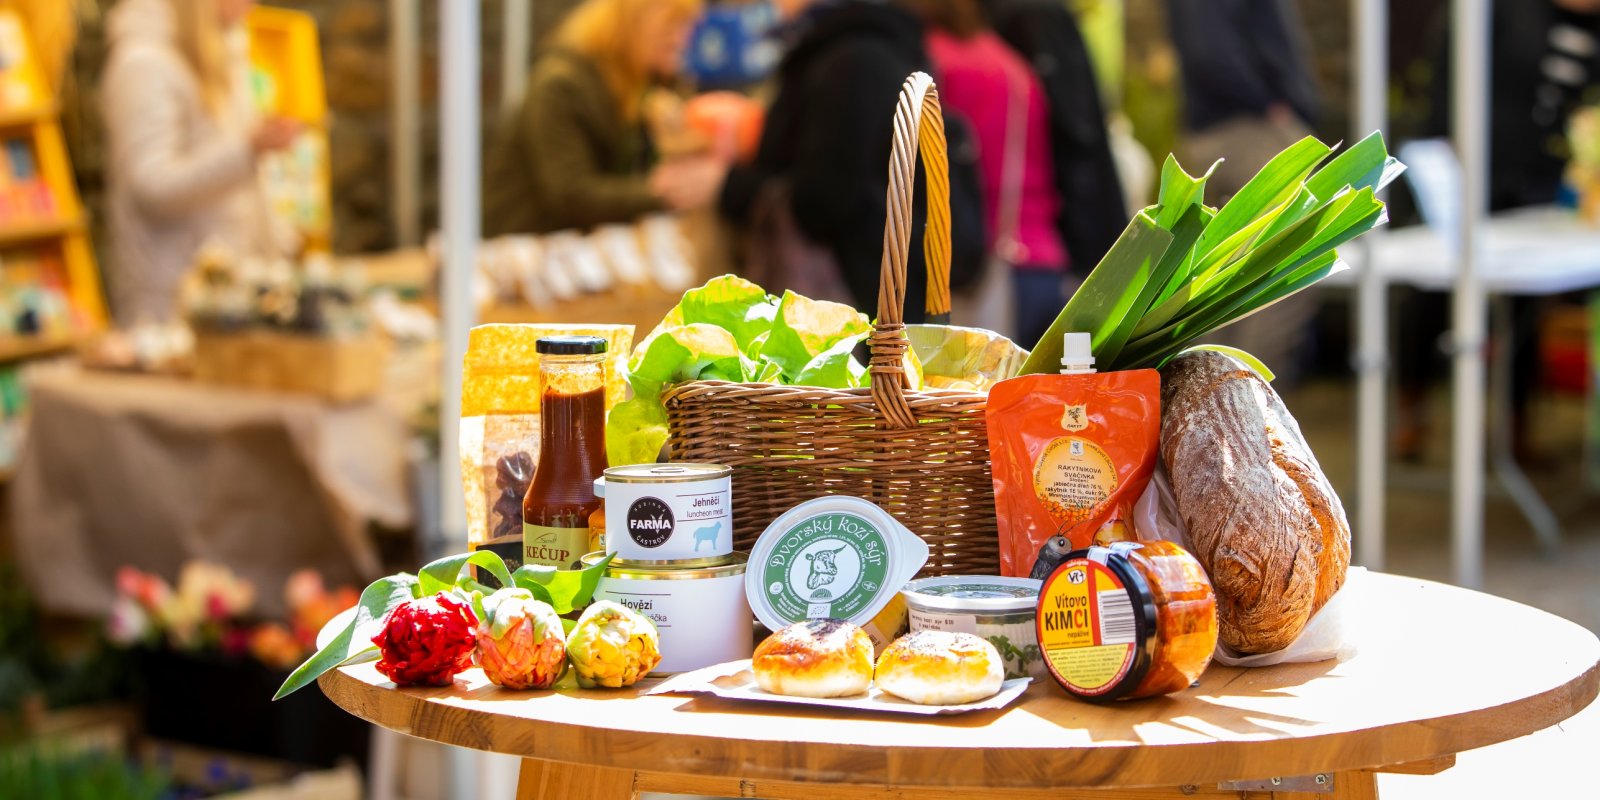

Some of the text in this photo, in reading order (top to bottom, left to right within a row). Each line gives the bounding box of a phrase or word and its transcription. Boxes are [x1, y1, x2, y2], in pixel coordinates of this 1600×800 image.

[1064, 471, 1095, 480] SVAČINKA
[686, 509, 713, 518] luncheon
[630, 519, 672, 530] FARMA
[769, 515, 833, 568] Dvorský
[837, 516, 871, 542] kozí
[865, 541, 882, 566] sýr
[526, 544, 570, 562] KEČUP
[620, 598, 653, 610] Hovězí
[1055, 593, 1087, 609] Vítovo
[1045, 609, 1088, 631] KIMCI
